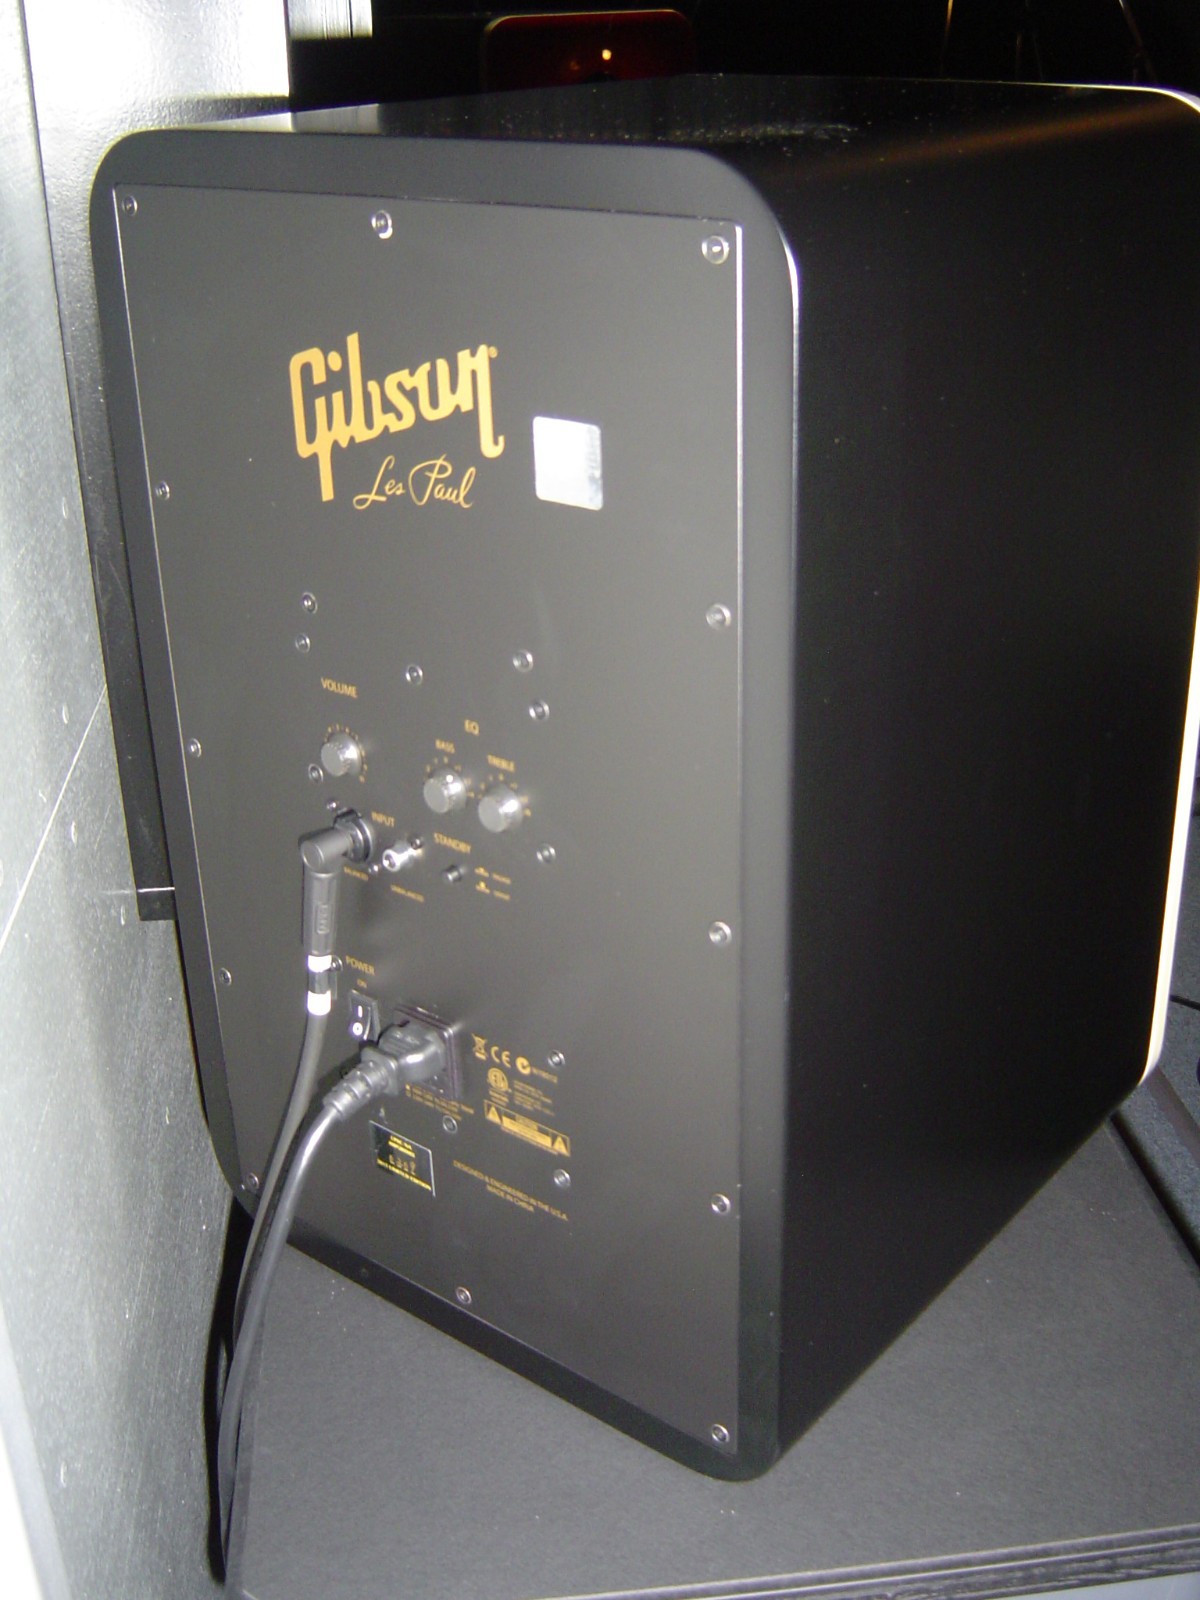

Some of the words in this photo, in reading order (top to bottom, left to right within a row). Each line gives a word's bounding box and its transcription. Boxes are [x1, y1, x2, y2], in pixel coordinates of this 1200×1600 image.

[353, 455, 405, 509] Les
[408, 454, 476, 508] Paul
[321, 677, 358, 699] VOLUME
[464, 719, 480, 736] EQ
[435, 739, 456, 755] BASS
[487, 754, 515, 773] TREBLE
[371, 811, 395, 828] INPUT
[433, 831, 471, 854] STANDBY
[345, 955, 375, 976] POWER
